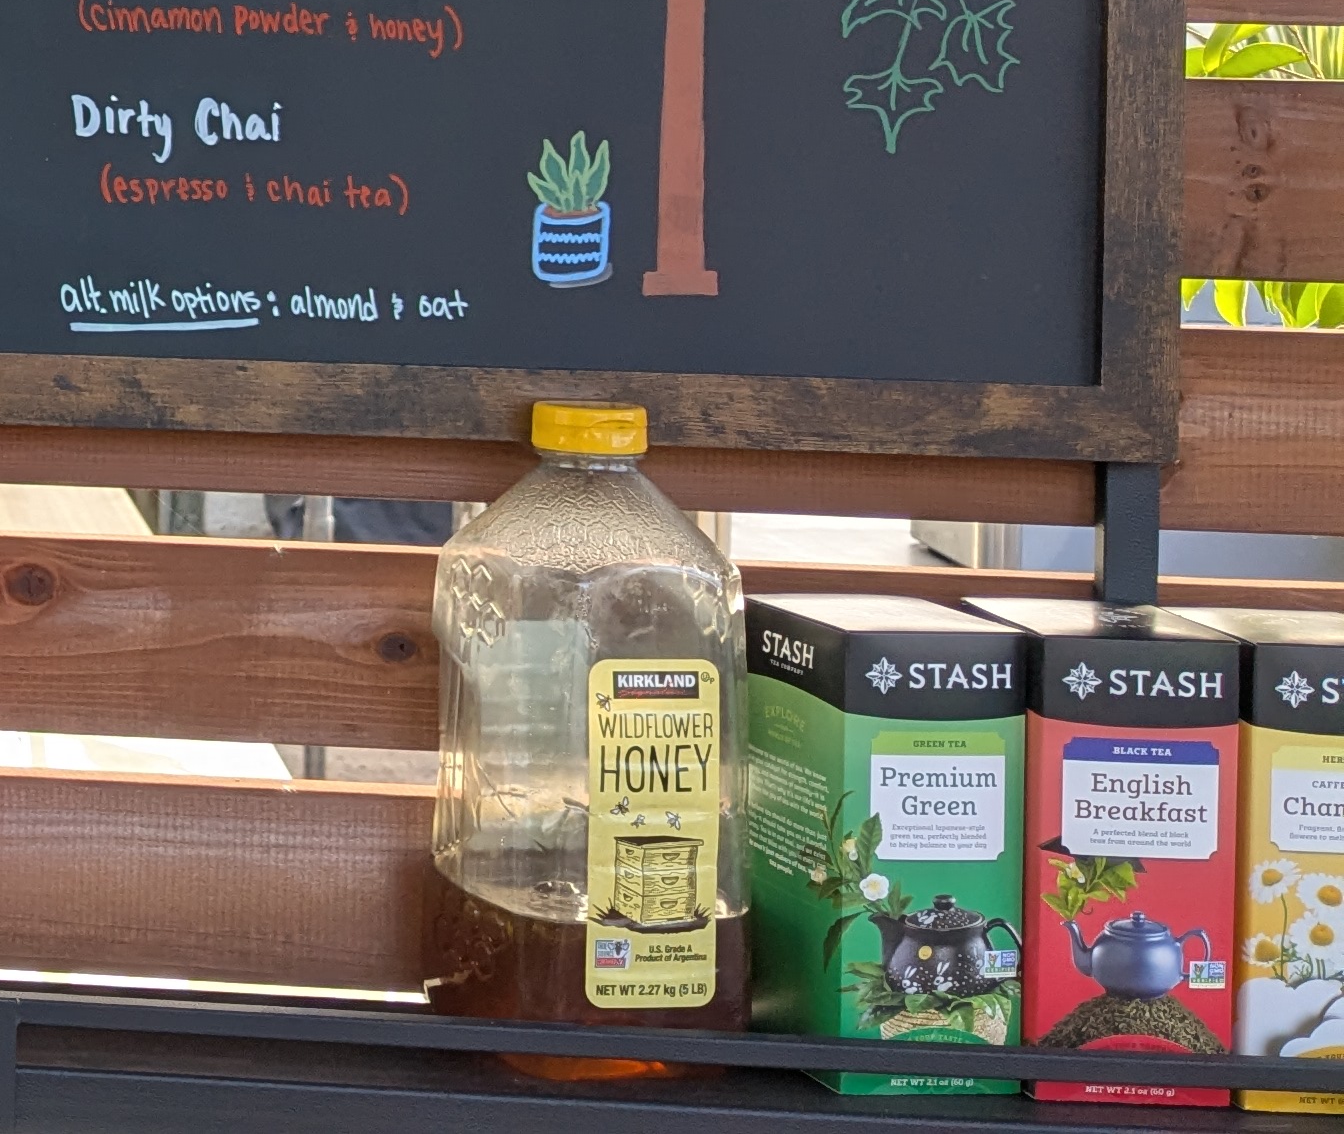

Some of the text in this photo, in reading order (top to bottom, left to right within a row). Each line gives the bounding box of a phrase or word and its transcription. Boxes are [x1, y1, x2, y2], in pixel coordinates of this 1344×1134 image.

[233, 2, 331, 37] powder
[369, 4, 466, 60] honey)
[71, 93, 284, 164] Dirty Chai
[100, 163, 228, 208] (espresso
[266, 174, 333, 207] chai
[343, 172, 411, 216] tea)
[59, 276, 108, 317] alt.
[109, 277, 165, 320] milk
[290, 285, 380, 322] almond
[418, 288, 469, 320] oat
[762, 630, 814, 669] STASH
[617, 674, 695, 688] KIRKLAND
[909, 663, 1012, 690] STASH
[1109, 669, 1223, 699] STASH
[598, 713, 713, 739] WILDFLOWER
[913, 740, 967, 748] GREEN TEA
[1113, 746, 1172, 757] BLACK TEA
[599, 743, 713, 793] HONEY
[880, 766, 997, 788] Premium
[1091, 772, 1193, 799] English
[901, 795, 978, 816] Green
[1074, 799, 1208, 823] Breakfast
[596, 985, 617, 996] NET
[619, 985, 636, 996] WT
[638, 984, 660, 996] 2.27
[663, 984, 676, 997] kg
